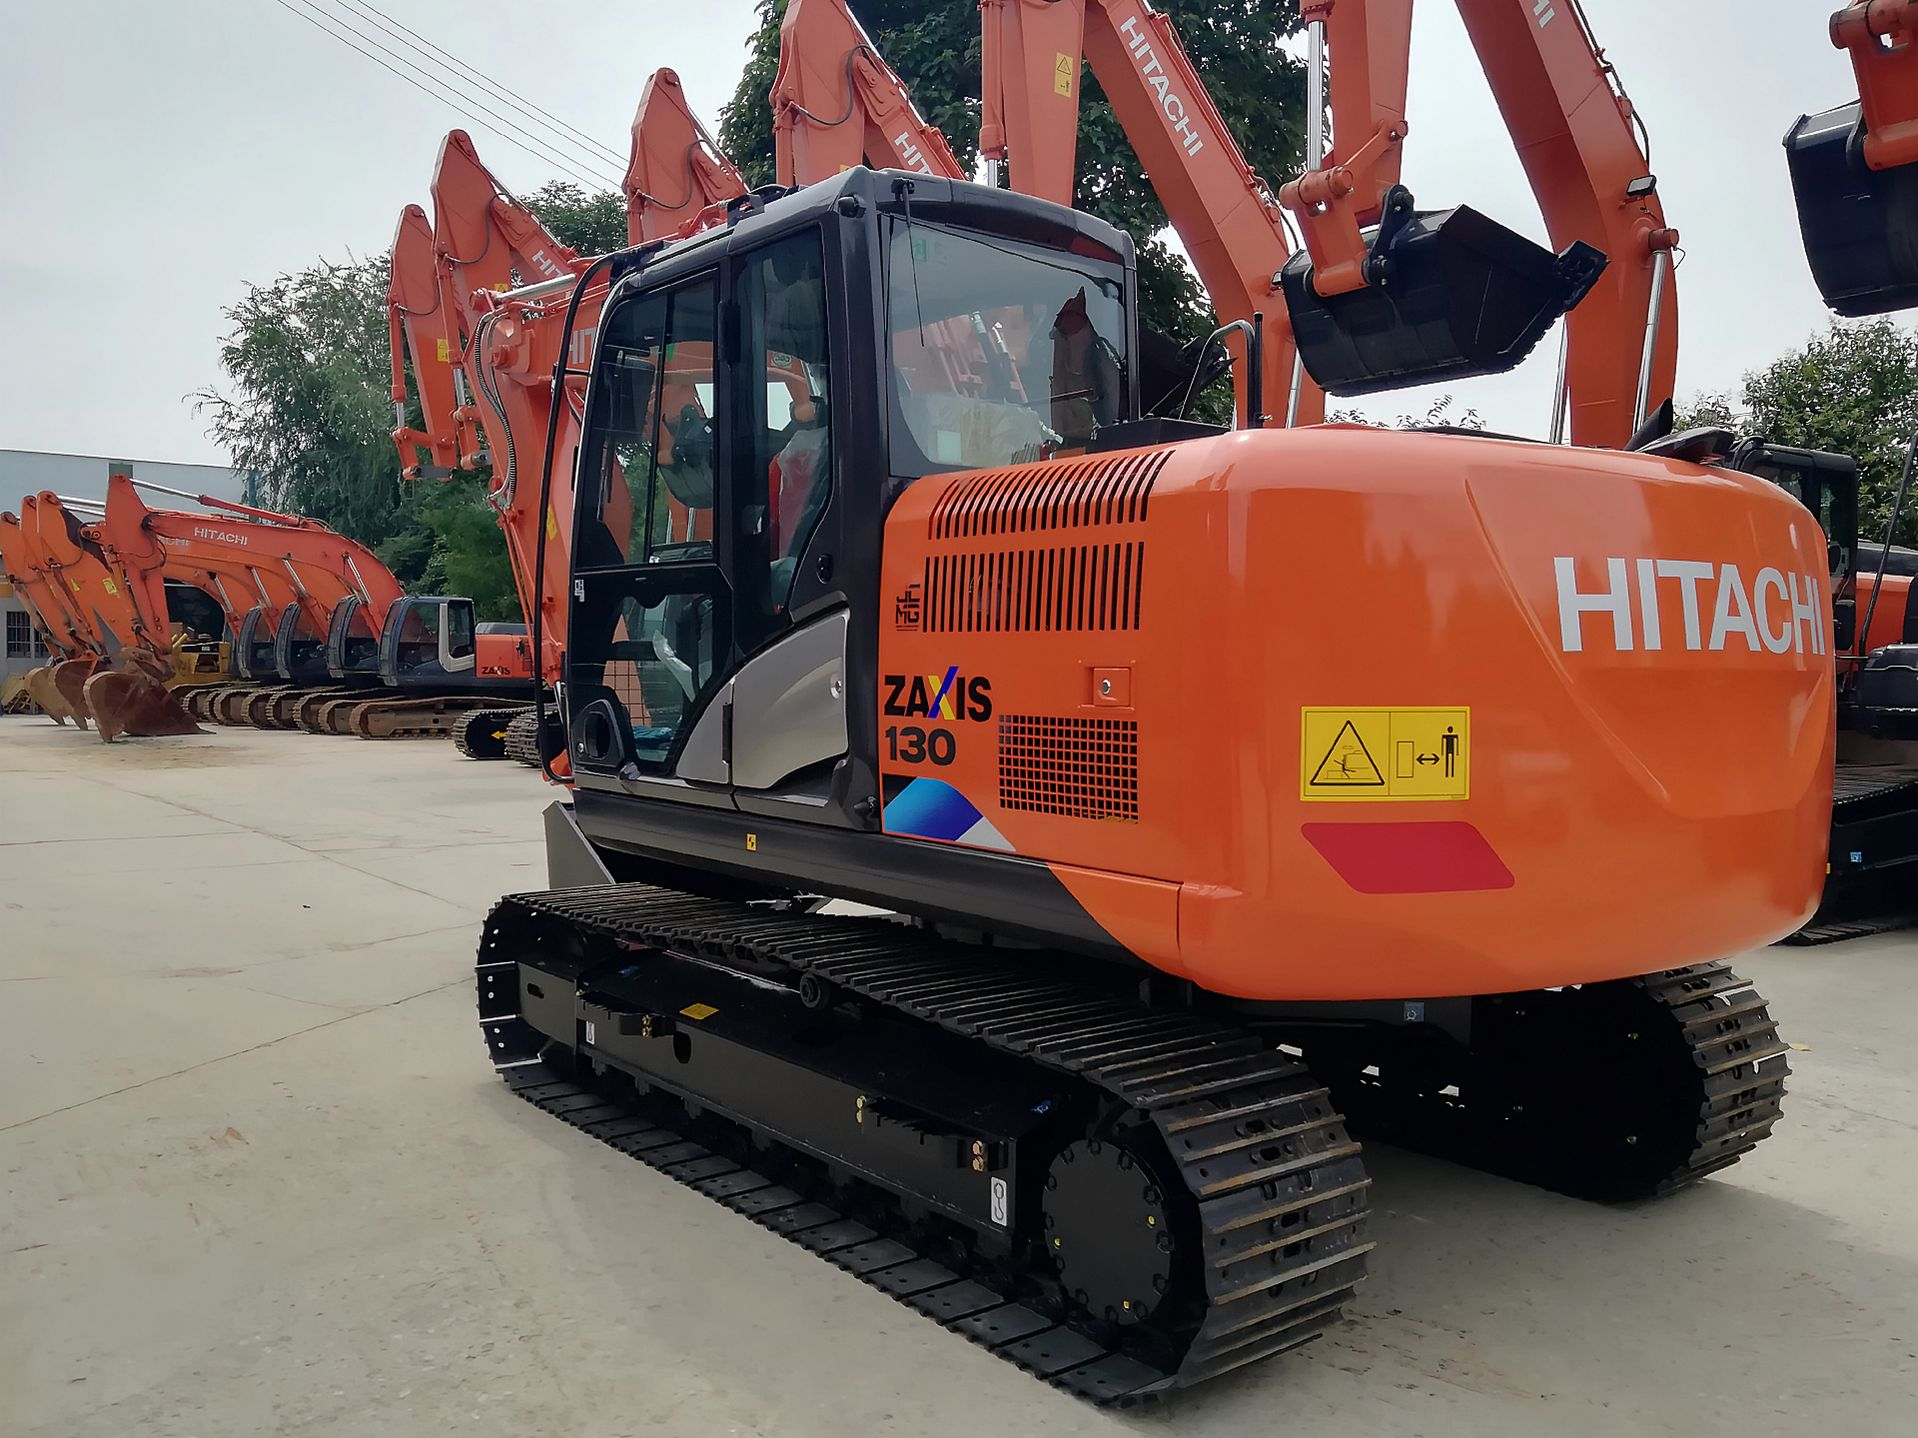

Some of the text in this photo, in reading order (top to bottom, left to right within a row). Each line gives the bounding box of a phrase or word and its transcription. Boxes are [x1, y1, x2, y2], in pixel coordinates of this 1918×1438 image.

[1120, 15, 1204, 157] HITACHI
[194, 527, 248, 546] HITACHI
[1553, 556, 1826, 656] HITACHI
[883, 665, 993, 723] ZAXIS
[885, 725, 956, 766] 130
